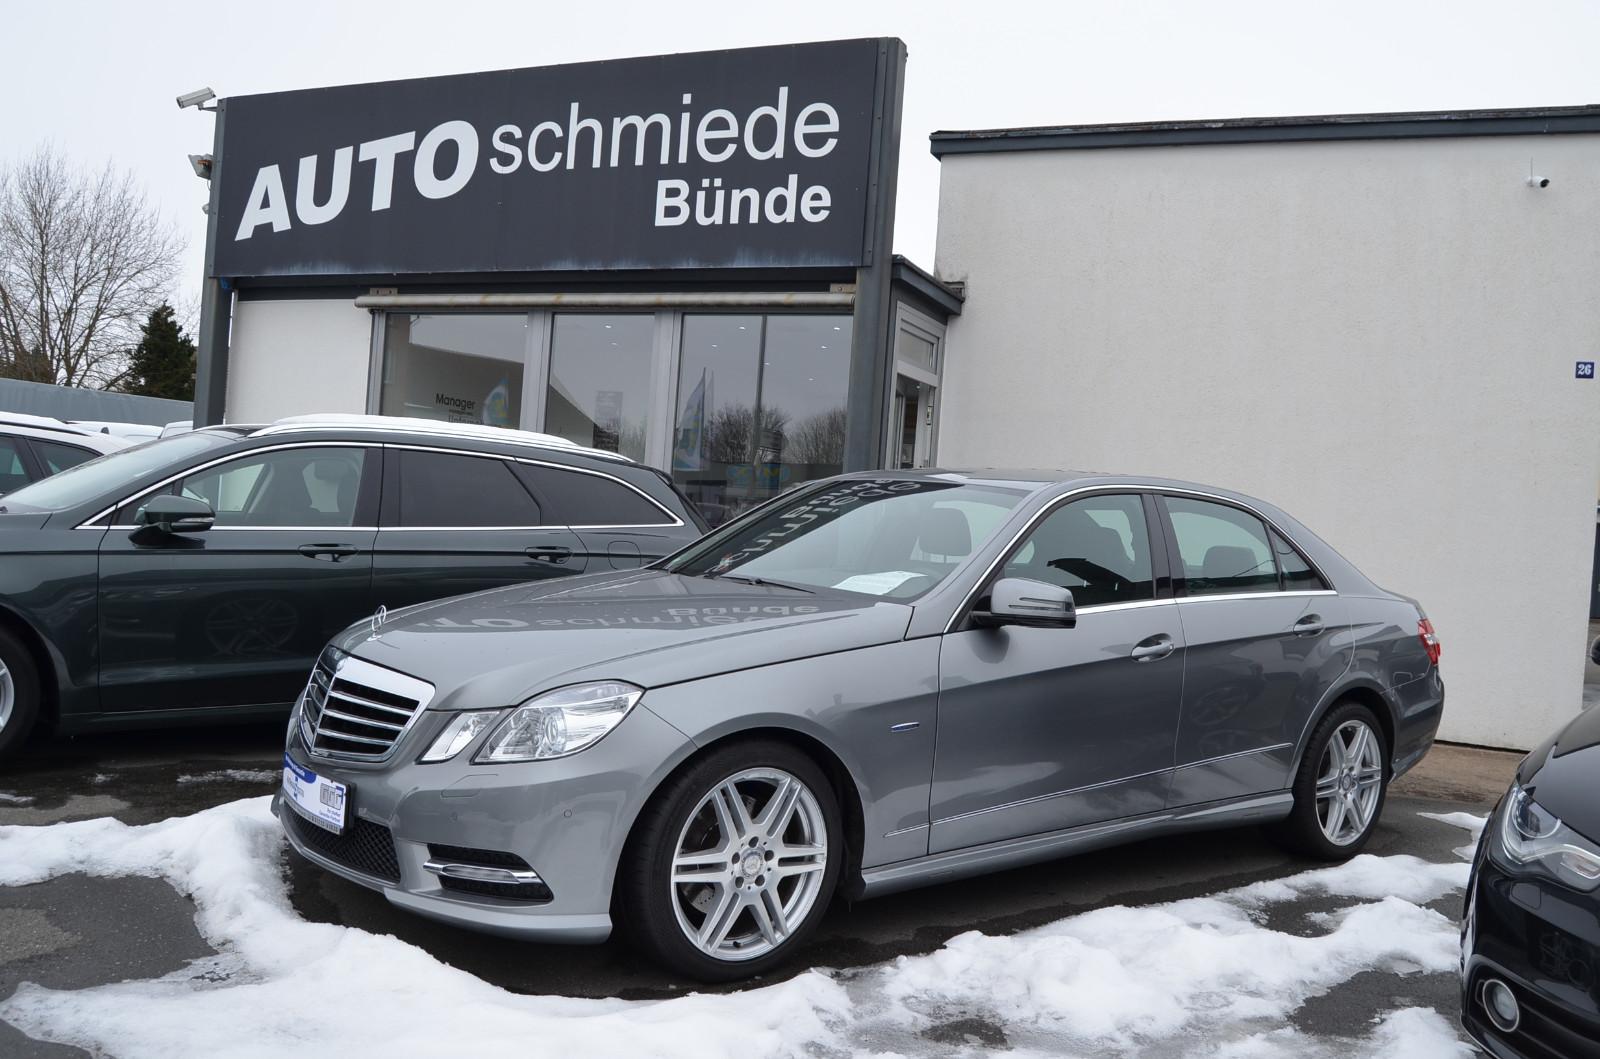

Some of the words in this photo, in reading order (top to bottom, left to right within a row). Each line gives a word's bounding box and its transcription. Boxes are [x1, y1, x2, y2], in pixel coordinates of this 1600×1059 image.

[654, 173, 832, 228] Bünde
[1577, 363, 1592, 376] 26
[435, 393, 476, 411] Manager
